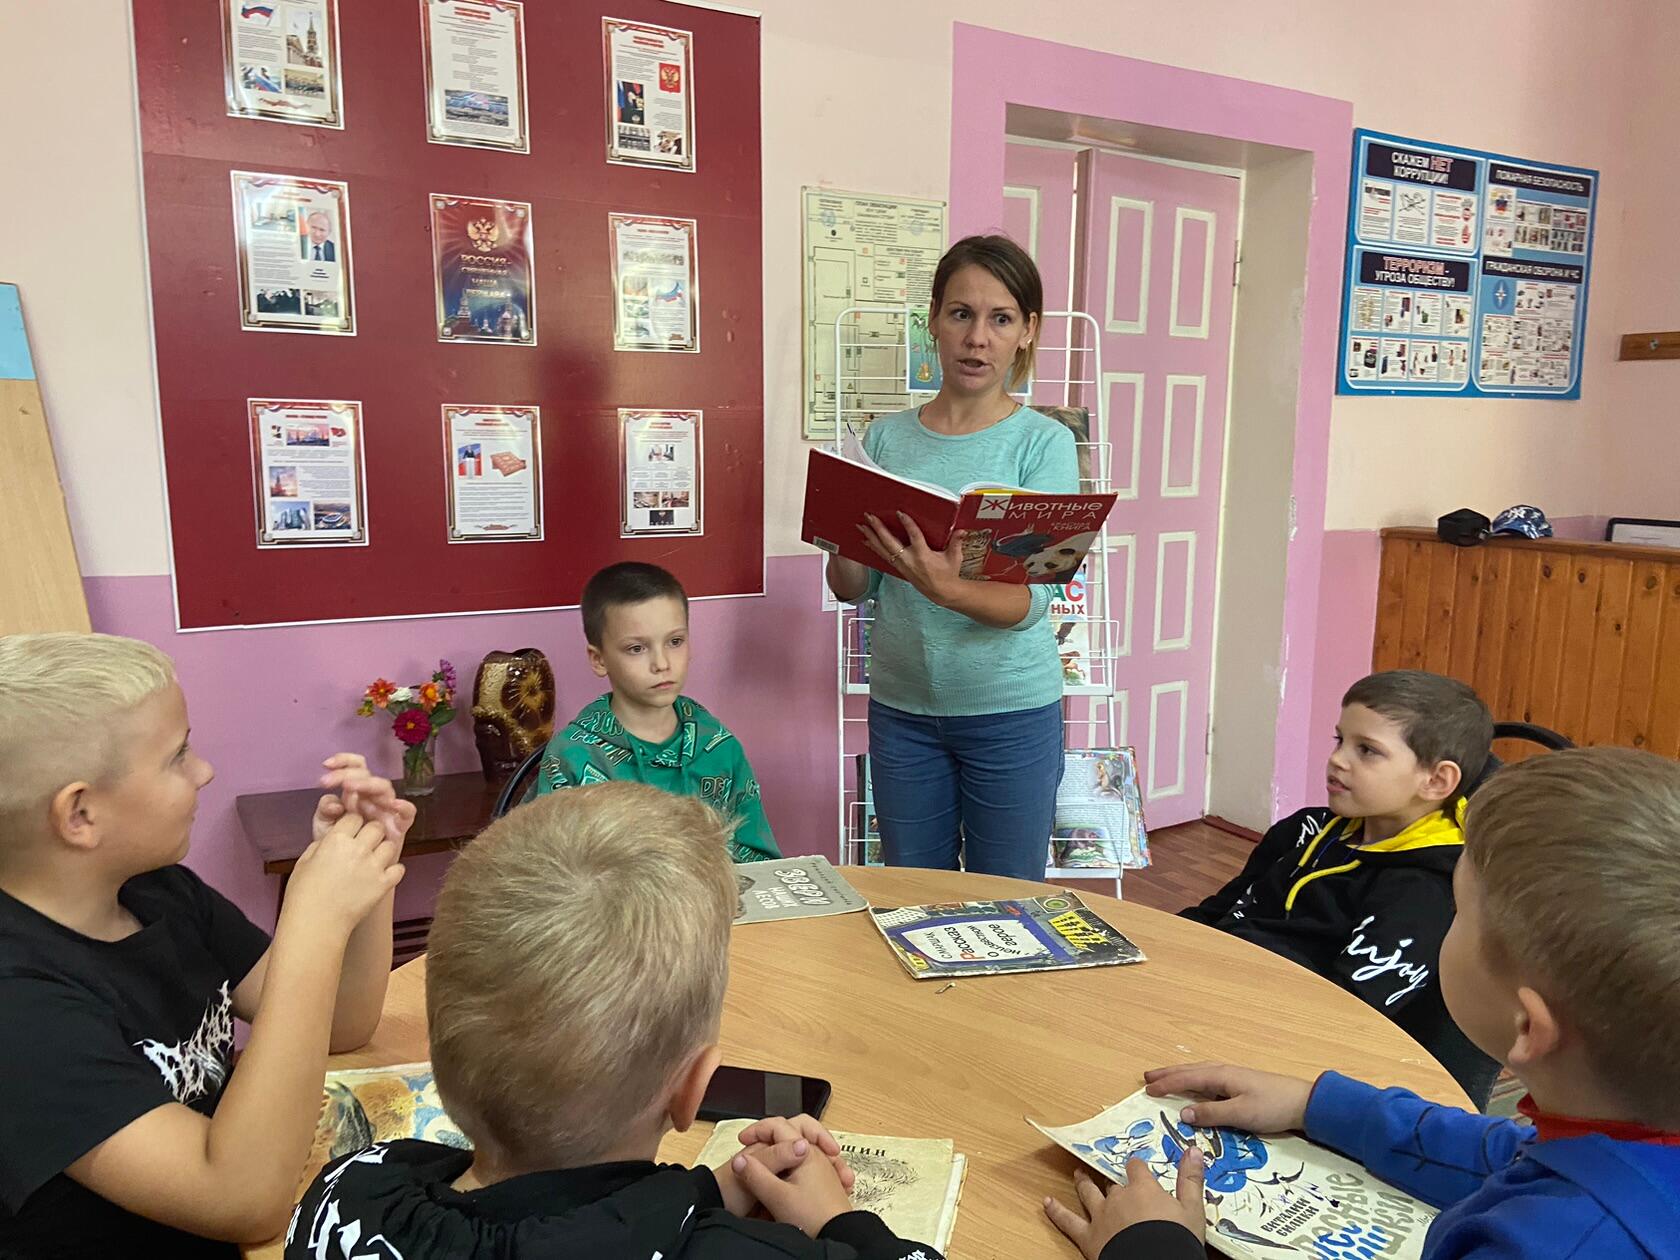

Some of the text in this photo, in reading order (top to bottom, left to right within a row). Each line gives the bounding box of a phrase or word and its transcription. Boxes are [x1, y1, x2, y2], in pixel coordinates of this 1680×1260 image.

[1430, 156, 1454, 172] НЕТ
[1383, 256, 1444, 275] ТЕРРОРИЗМ
[1374, 270, 1406, 283] УГРОЗА
[1009, 511, 1097, 519] МИРА
[1053, 580, 1084, 602] АС
[1051, 604, 1084, 615] НЫХ
[944, 926, 986, 960] Рассказ
[967, 925, 1021, 955] неизвестном
[988, 923, 1018, 947] герое
[841, 1144, 885, 1157] ШИН
